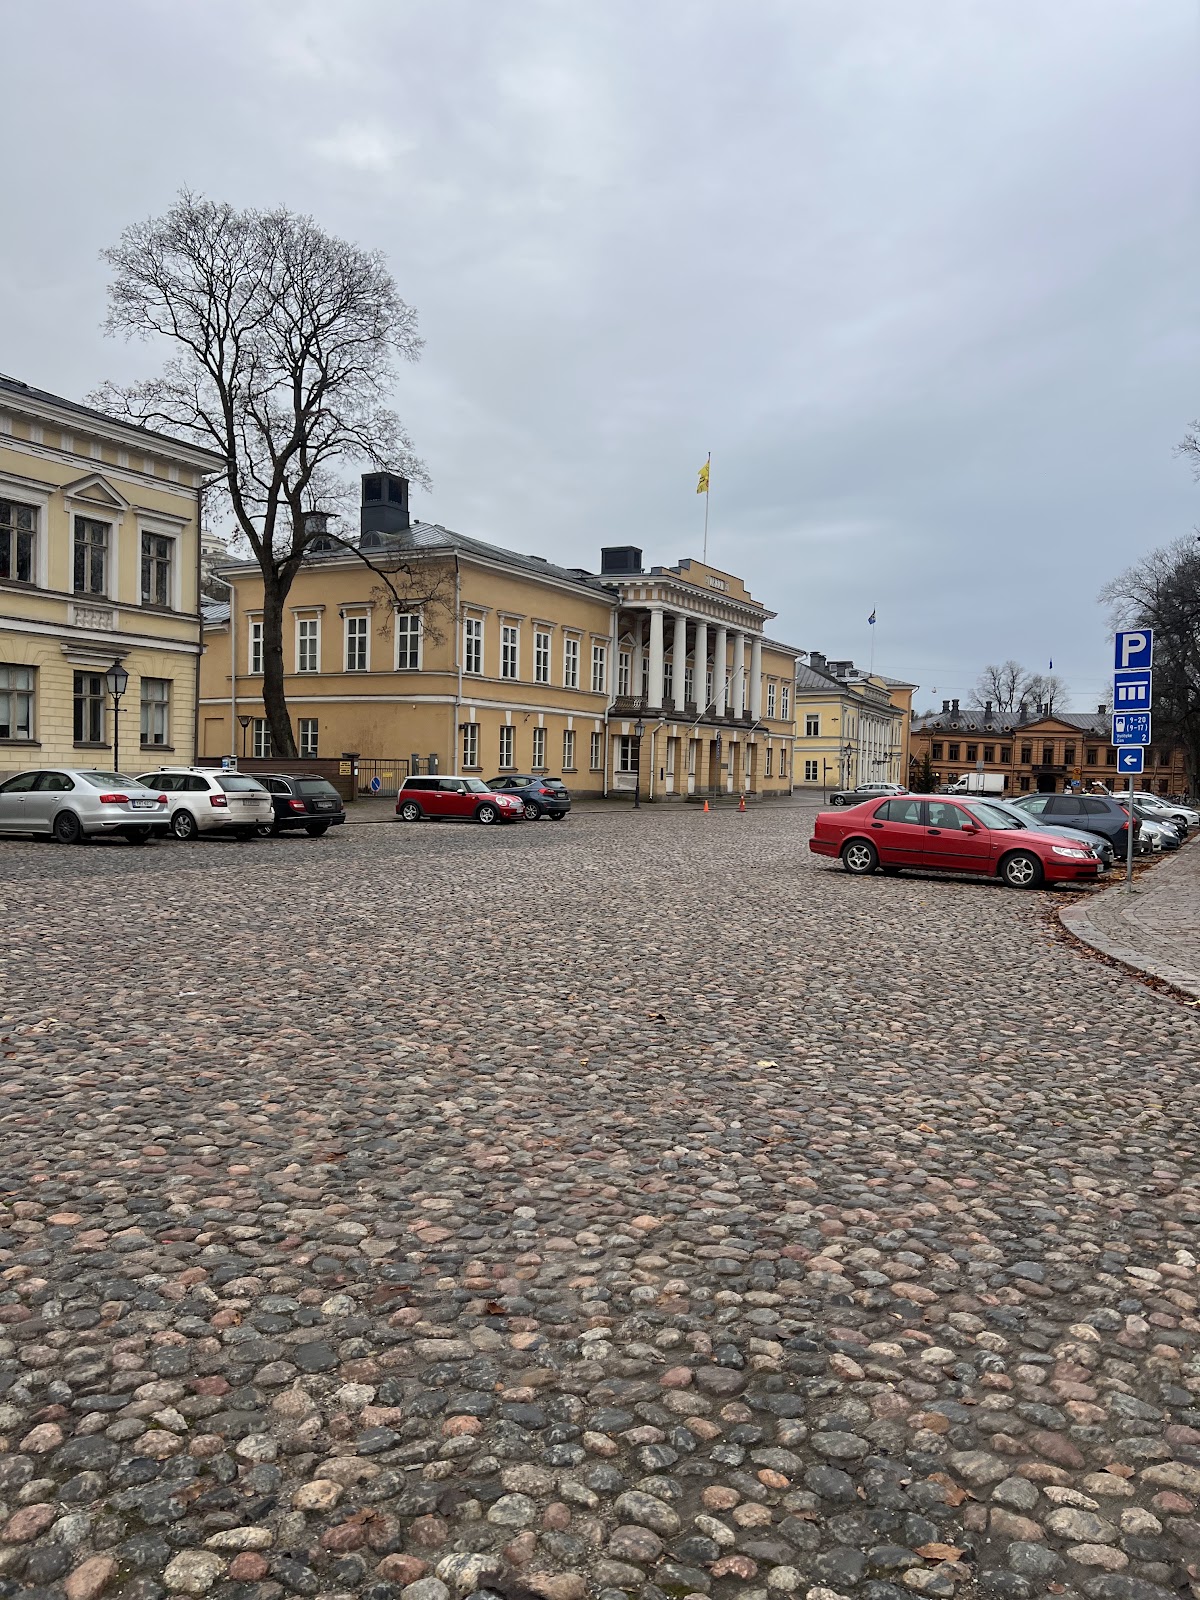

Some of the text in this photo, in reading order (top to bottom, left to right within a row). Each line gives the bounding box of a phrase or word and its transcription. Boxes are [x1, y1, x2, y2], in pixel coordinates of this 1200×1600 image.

[1122, 633, 1146, 667] P
[1129, 716, 1147, 724] 9-20
[1141, 733, 1147, 742] 2
